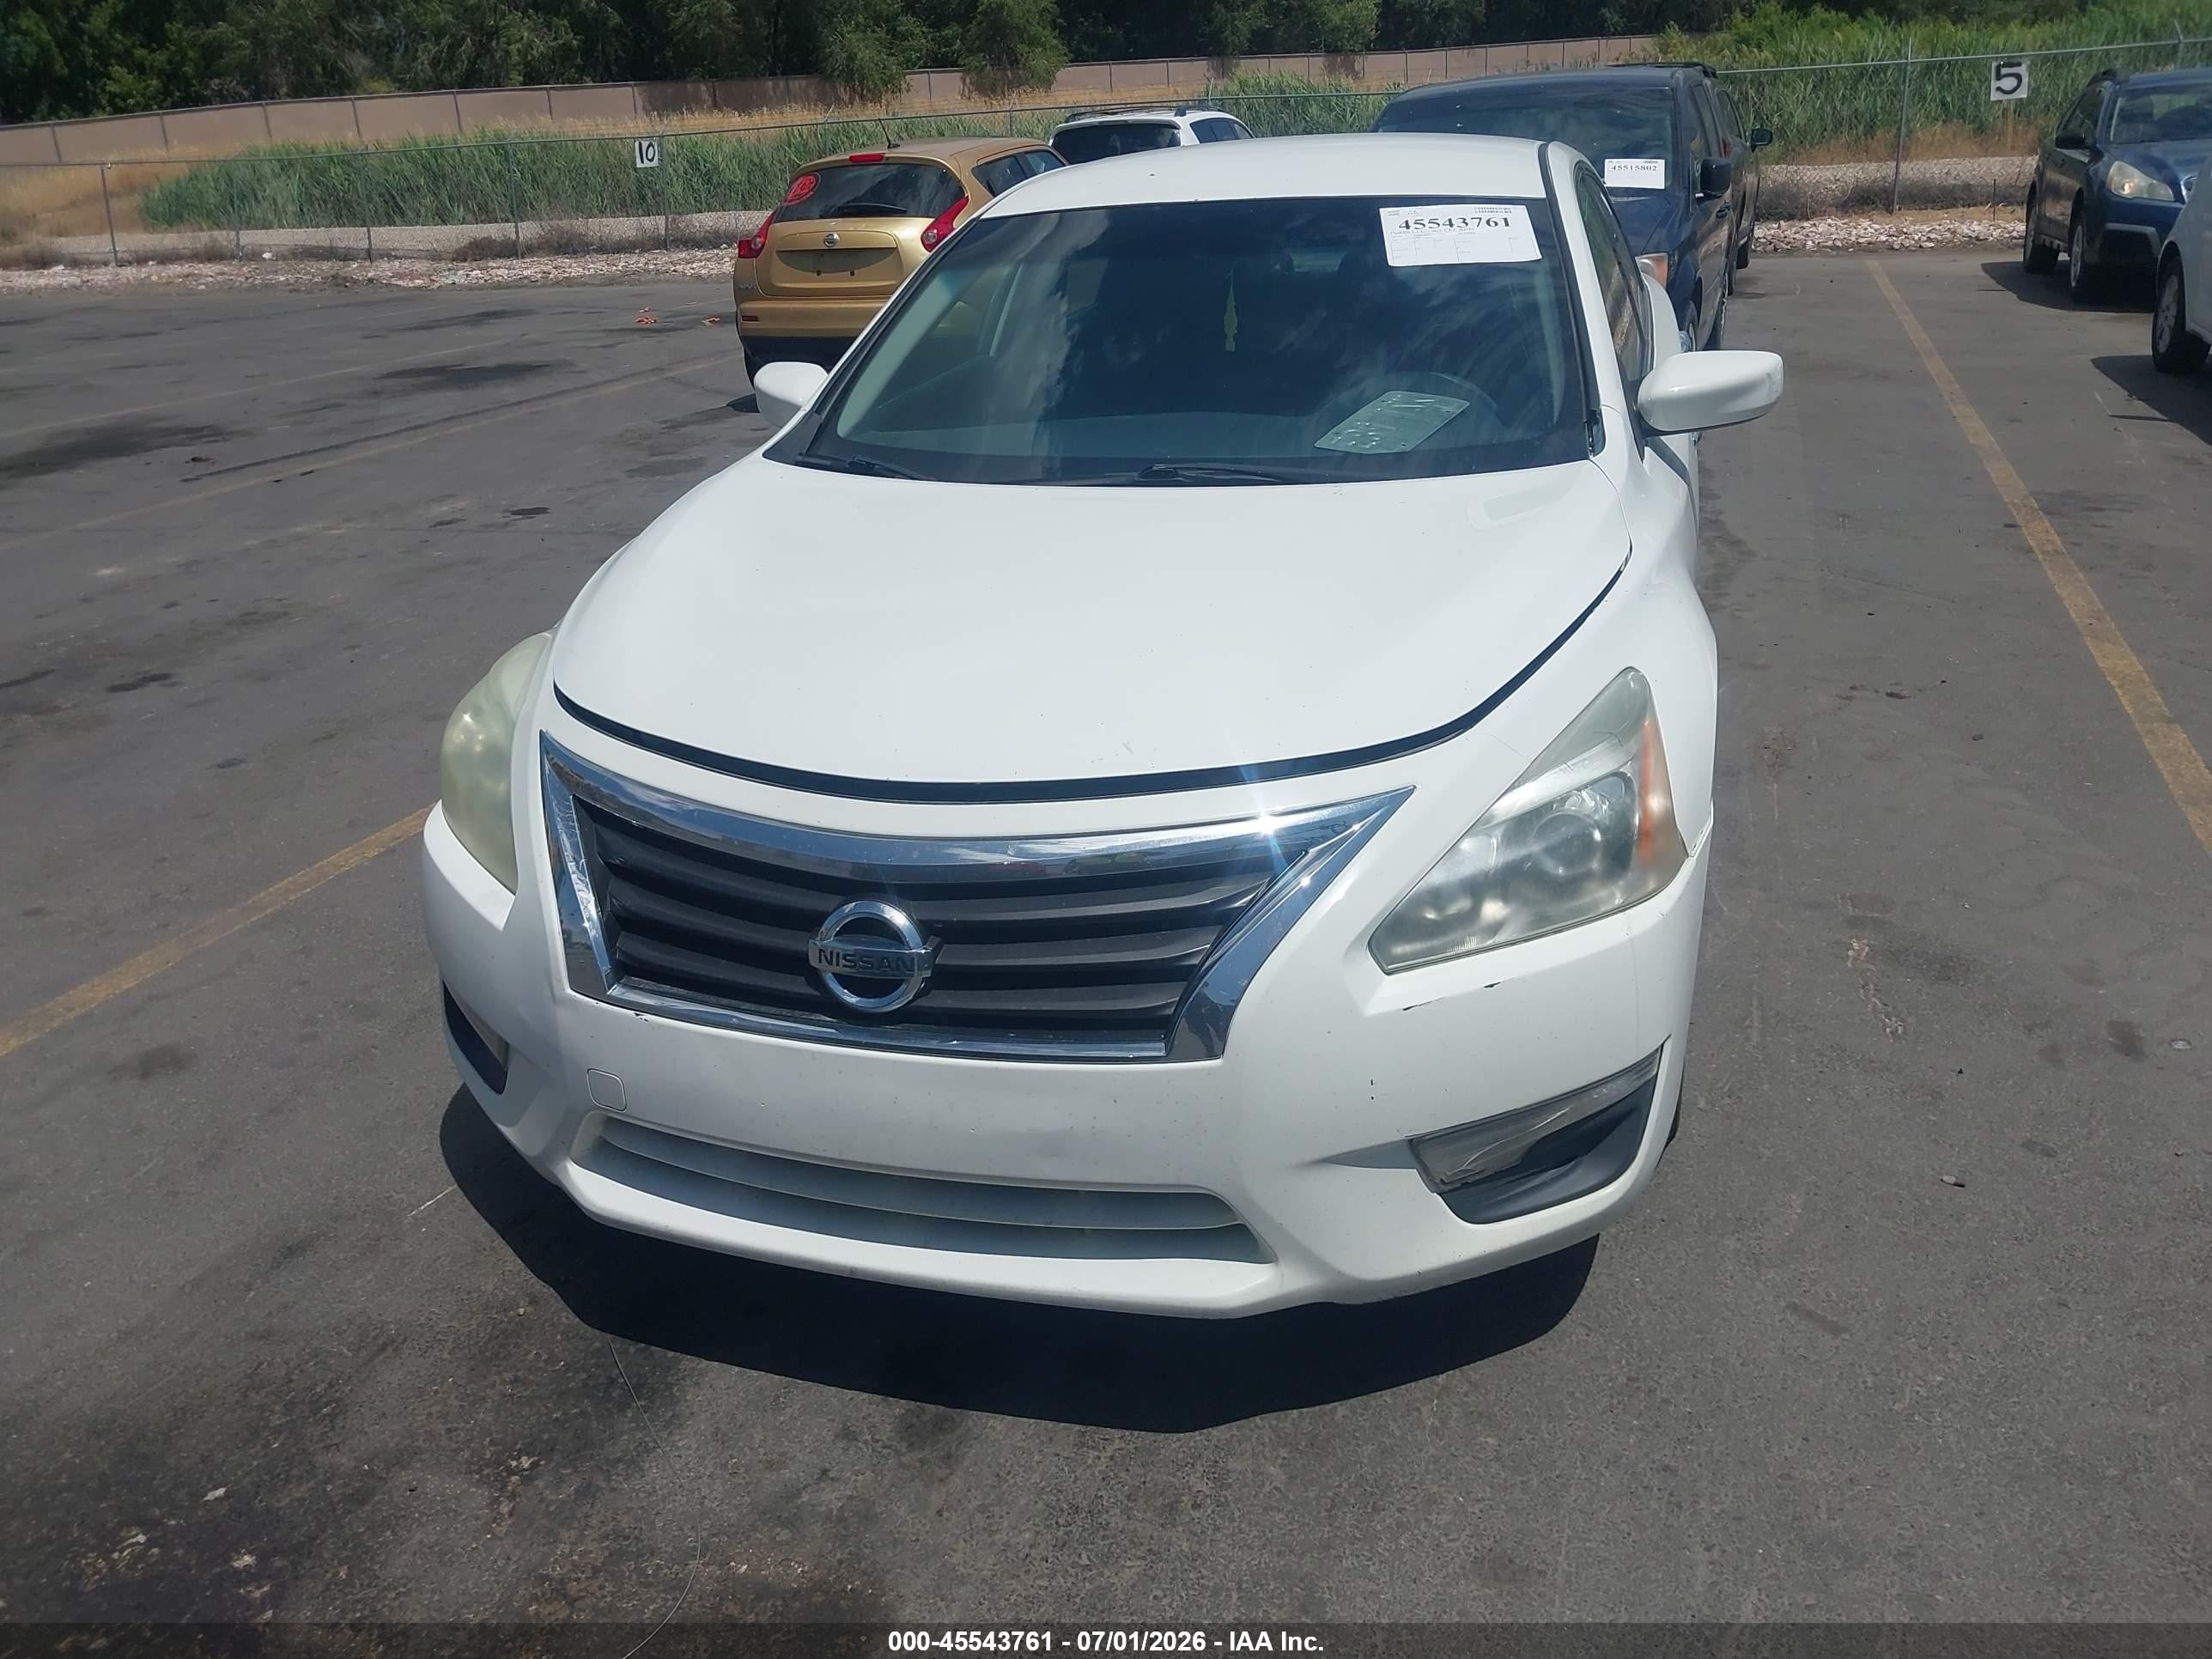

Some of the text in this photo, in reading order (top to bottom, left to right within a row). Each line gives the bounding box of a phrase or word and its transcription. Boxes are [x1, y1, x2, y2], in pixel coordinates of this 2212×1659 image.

[1995, 61, 2023, 94] 5
[638, 141, 656, 164] 10
[1398, 216, 1511, 230] 45543761
[818, 949, 915, 973] NISSAN
